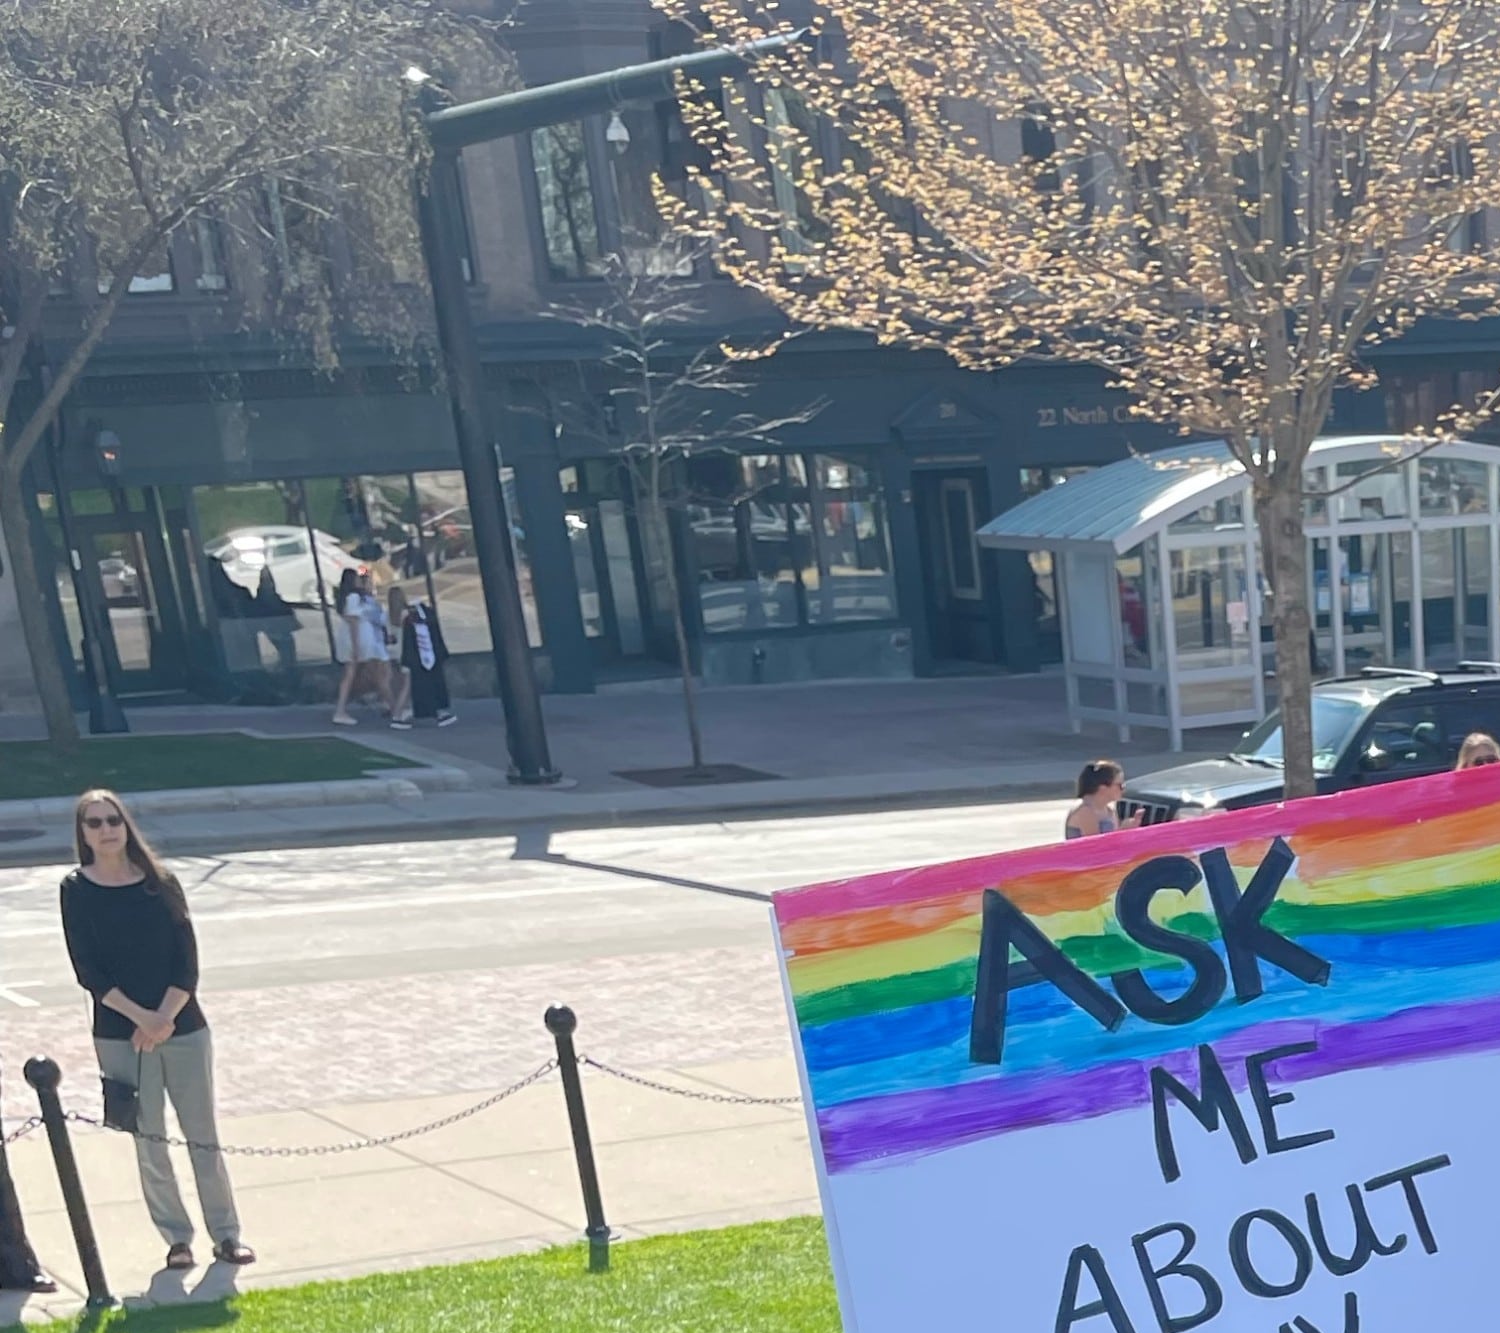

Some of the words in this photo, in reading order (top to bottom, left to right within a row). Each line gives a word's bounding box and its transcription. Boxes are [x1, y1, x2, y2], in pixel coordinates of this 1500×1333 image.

[1063, 406, 1108, 425] North
[968, 836, 1332, 1064] ASK
[1150, 1041, 1335, 1182] ME
